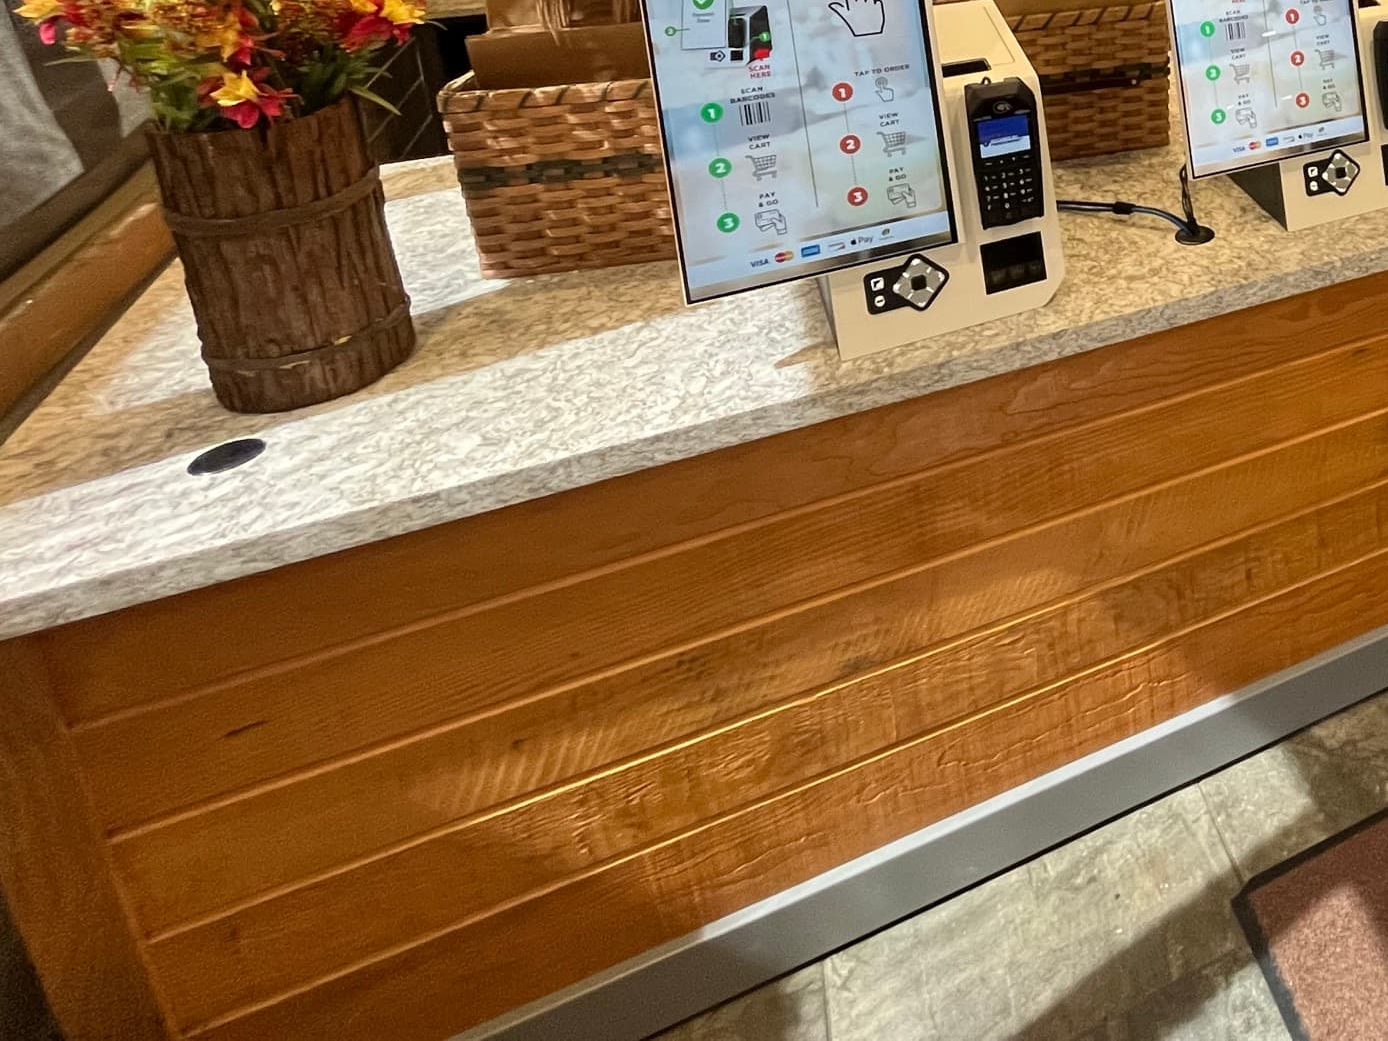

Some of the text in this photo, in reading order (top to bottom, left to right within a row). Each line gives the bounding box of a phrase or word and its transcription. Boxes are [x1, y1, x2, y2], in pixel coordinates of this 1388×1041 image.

[748, 64, 770, 72] SCAN
[884, 64, 910, 73] ORDER
[740, 86, 764, 94] SCAN
[730, 92, 776, 104] BARCODES
[878, 112, 899, 120] VIEW
[880, 119, 900, 128] CART
[748, 134, 770, 142] VIEW
[748, 142, 771, 150] CART
[846, 139, 856, 150] 2
[715, 163, 726, 174] 2
[895, 173, 907, 181] GO
[759, 192, 776, 200] PAY
[854, 192, 863, 202] 3
[724, 218, 734, 228] 3
[858, 236, 874, 245] Pay
[750, 258, 770, 268] VISA
